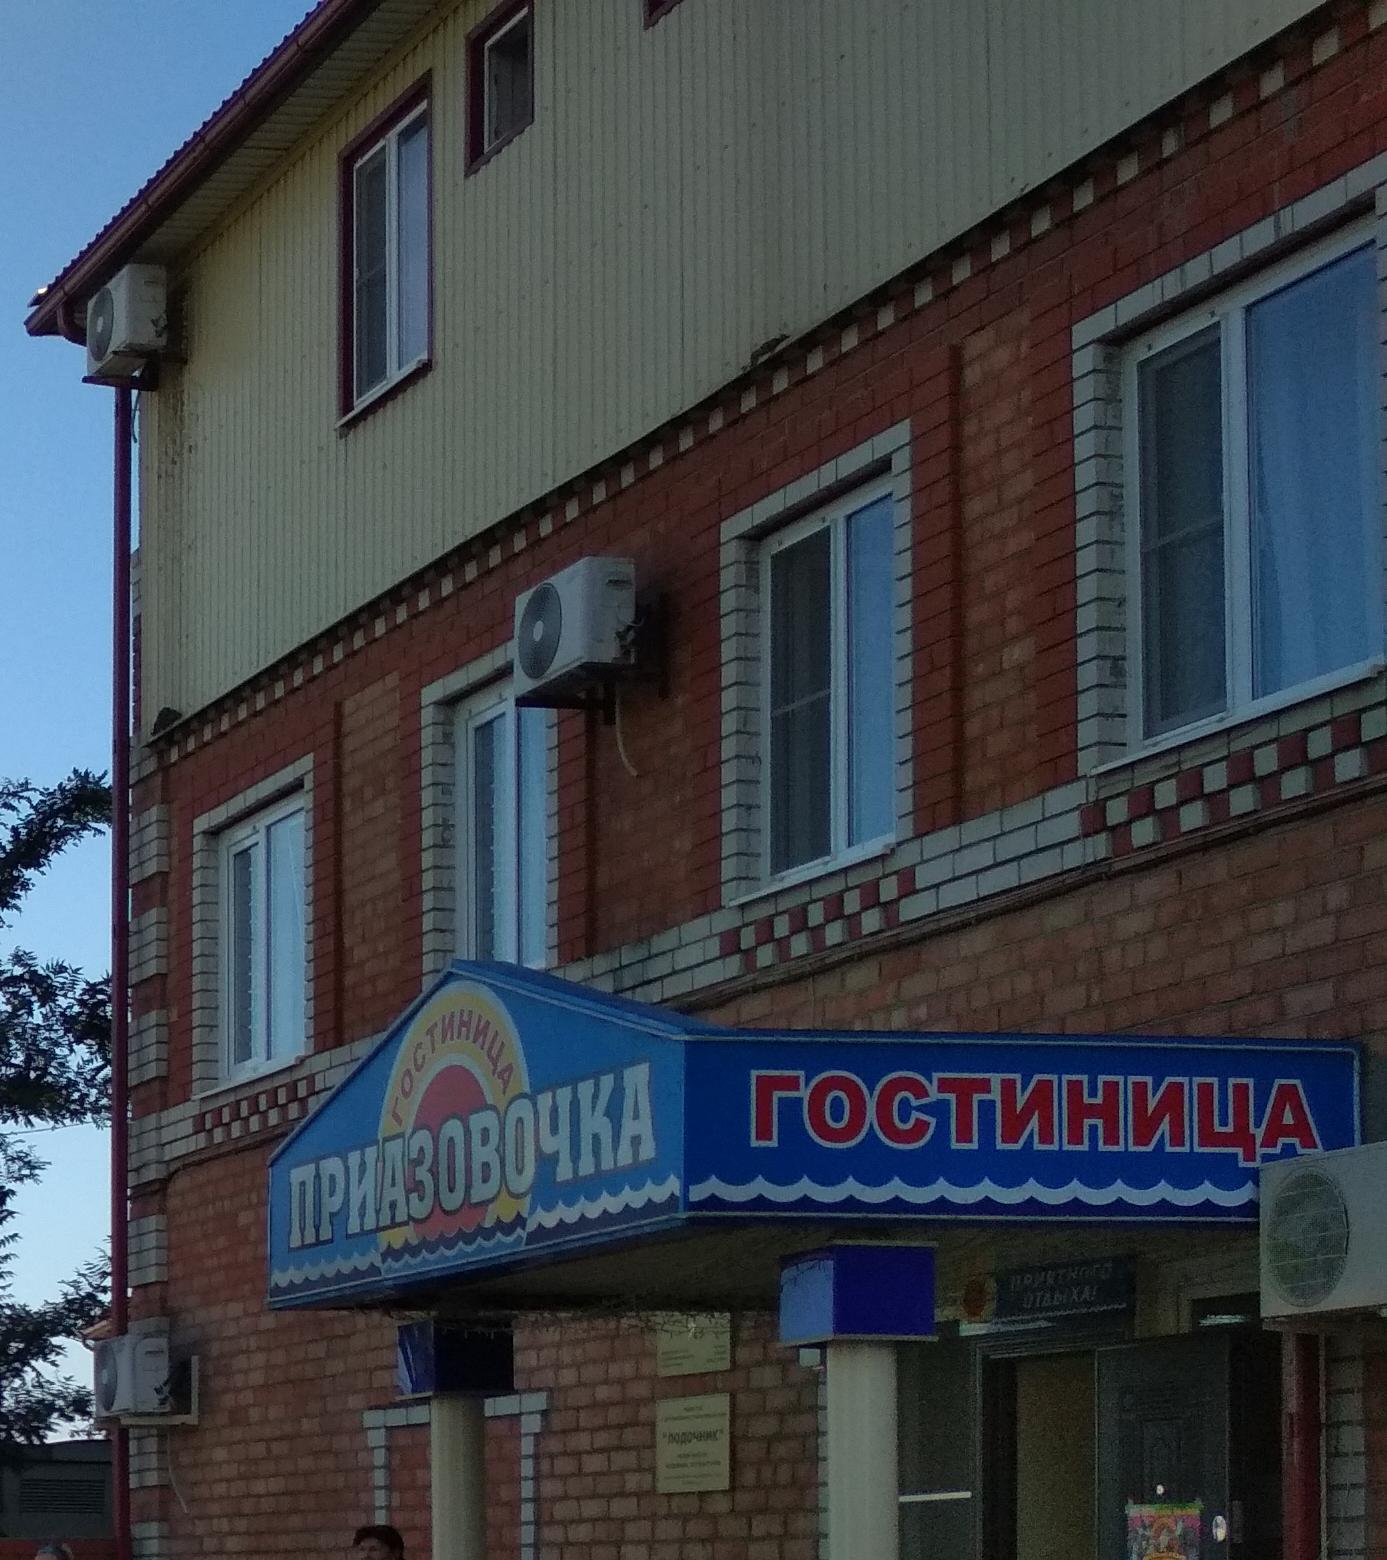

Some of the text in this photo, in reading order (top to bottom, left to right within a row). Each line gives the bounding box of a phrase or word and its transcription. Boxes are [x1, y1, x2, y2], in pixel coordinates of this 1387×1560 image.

[391, 1008, 516, 1127] ГОСТИНИЦА
[750, 1069, 1325, 1168] ГОСТИНИЦА
[288, 1061, 657, 1251] ПРИАЗОВОЧКА
[1023, 1286, 1097, 1308] ОТДЫХА!
